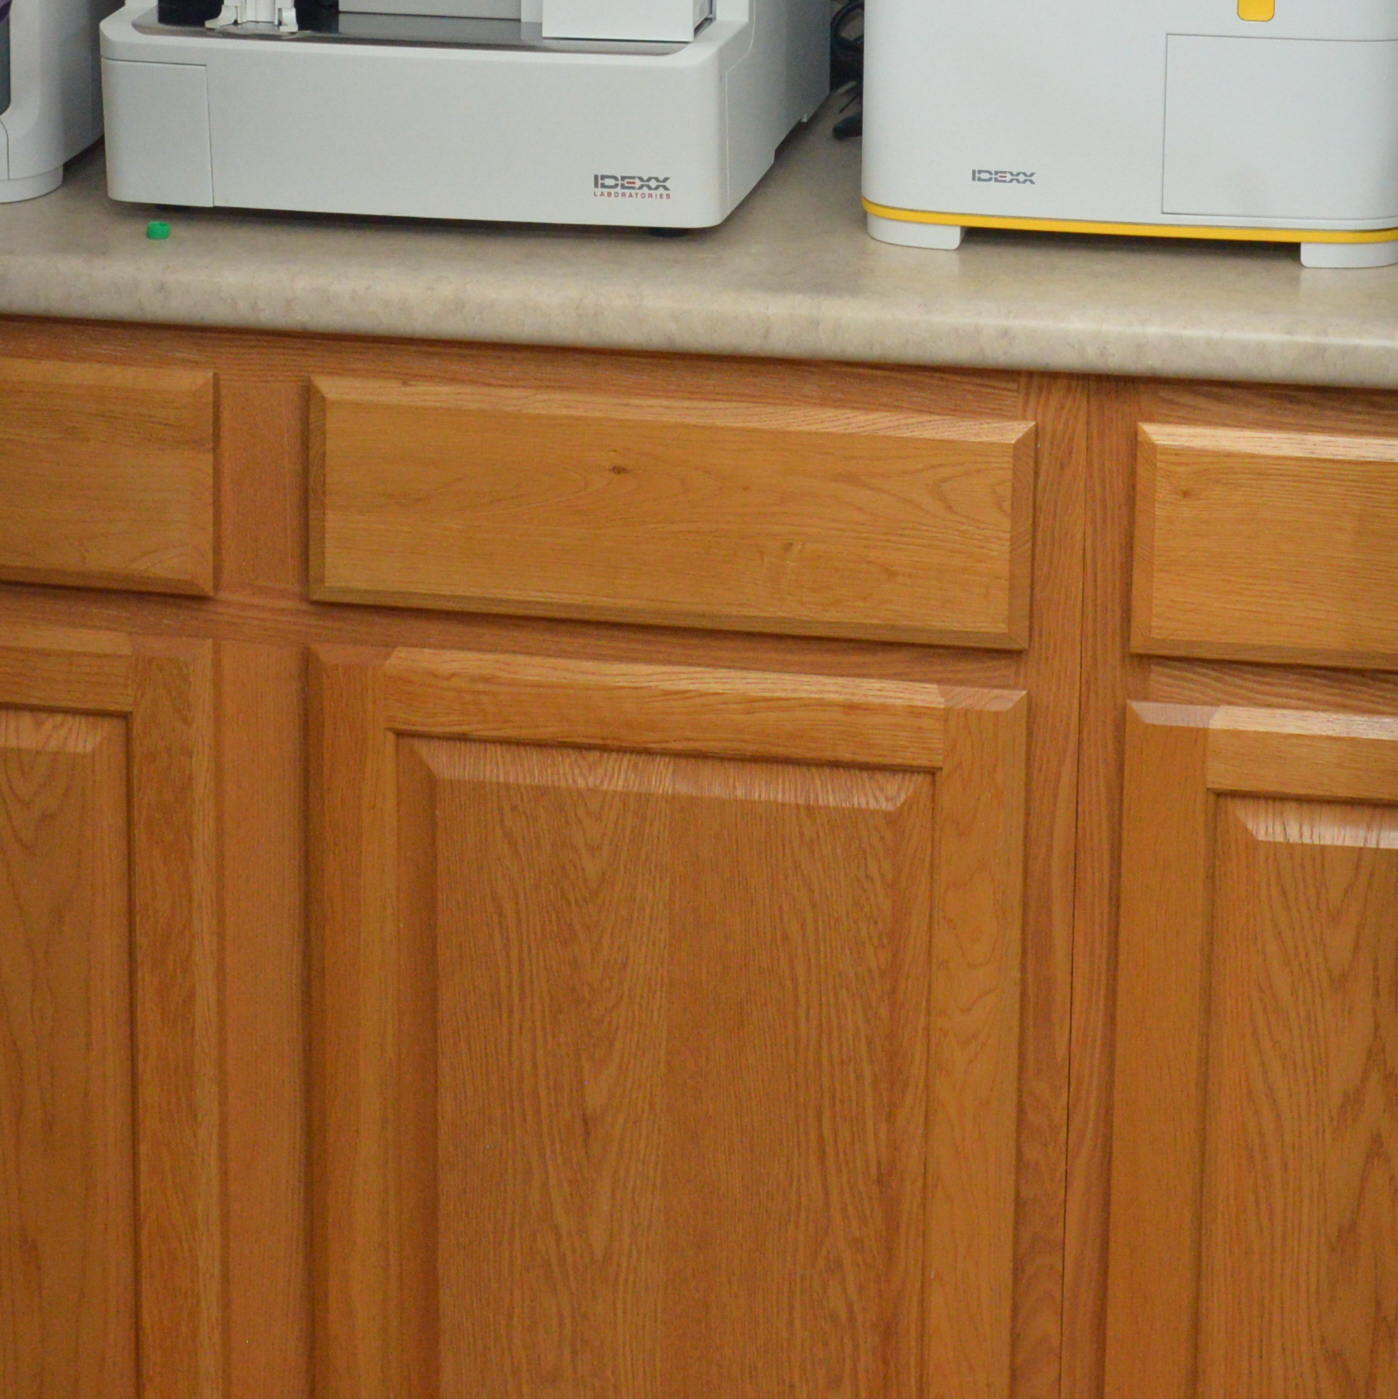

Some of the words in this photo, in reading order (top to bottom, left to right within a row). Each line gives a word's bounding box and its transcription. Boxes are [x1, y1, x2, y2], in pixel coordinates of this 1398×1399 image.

[593, 174, 670, 191] IDEXX
[972, 169, 1035, 185] IDEXX
[593, 191, 671, 199] LABORATORIES
